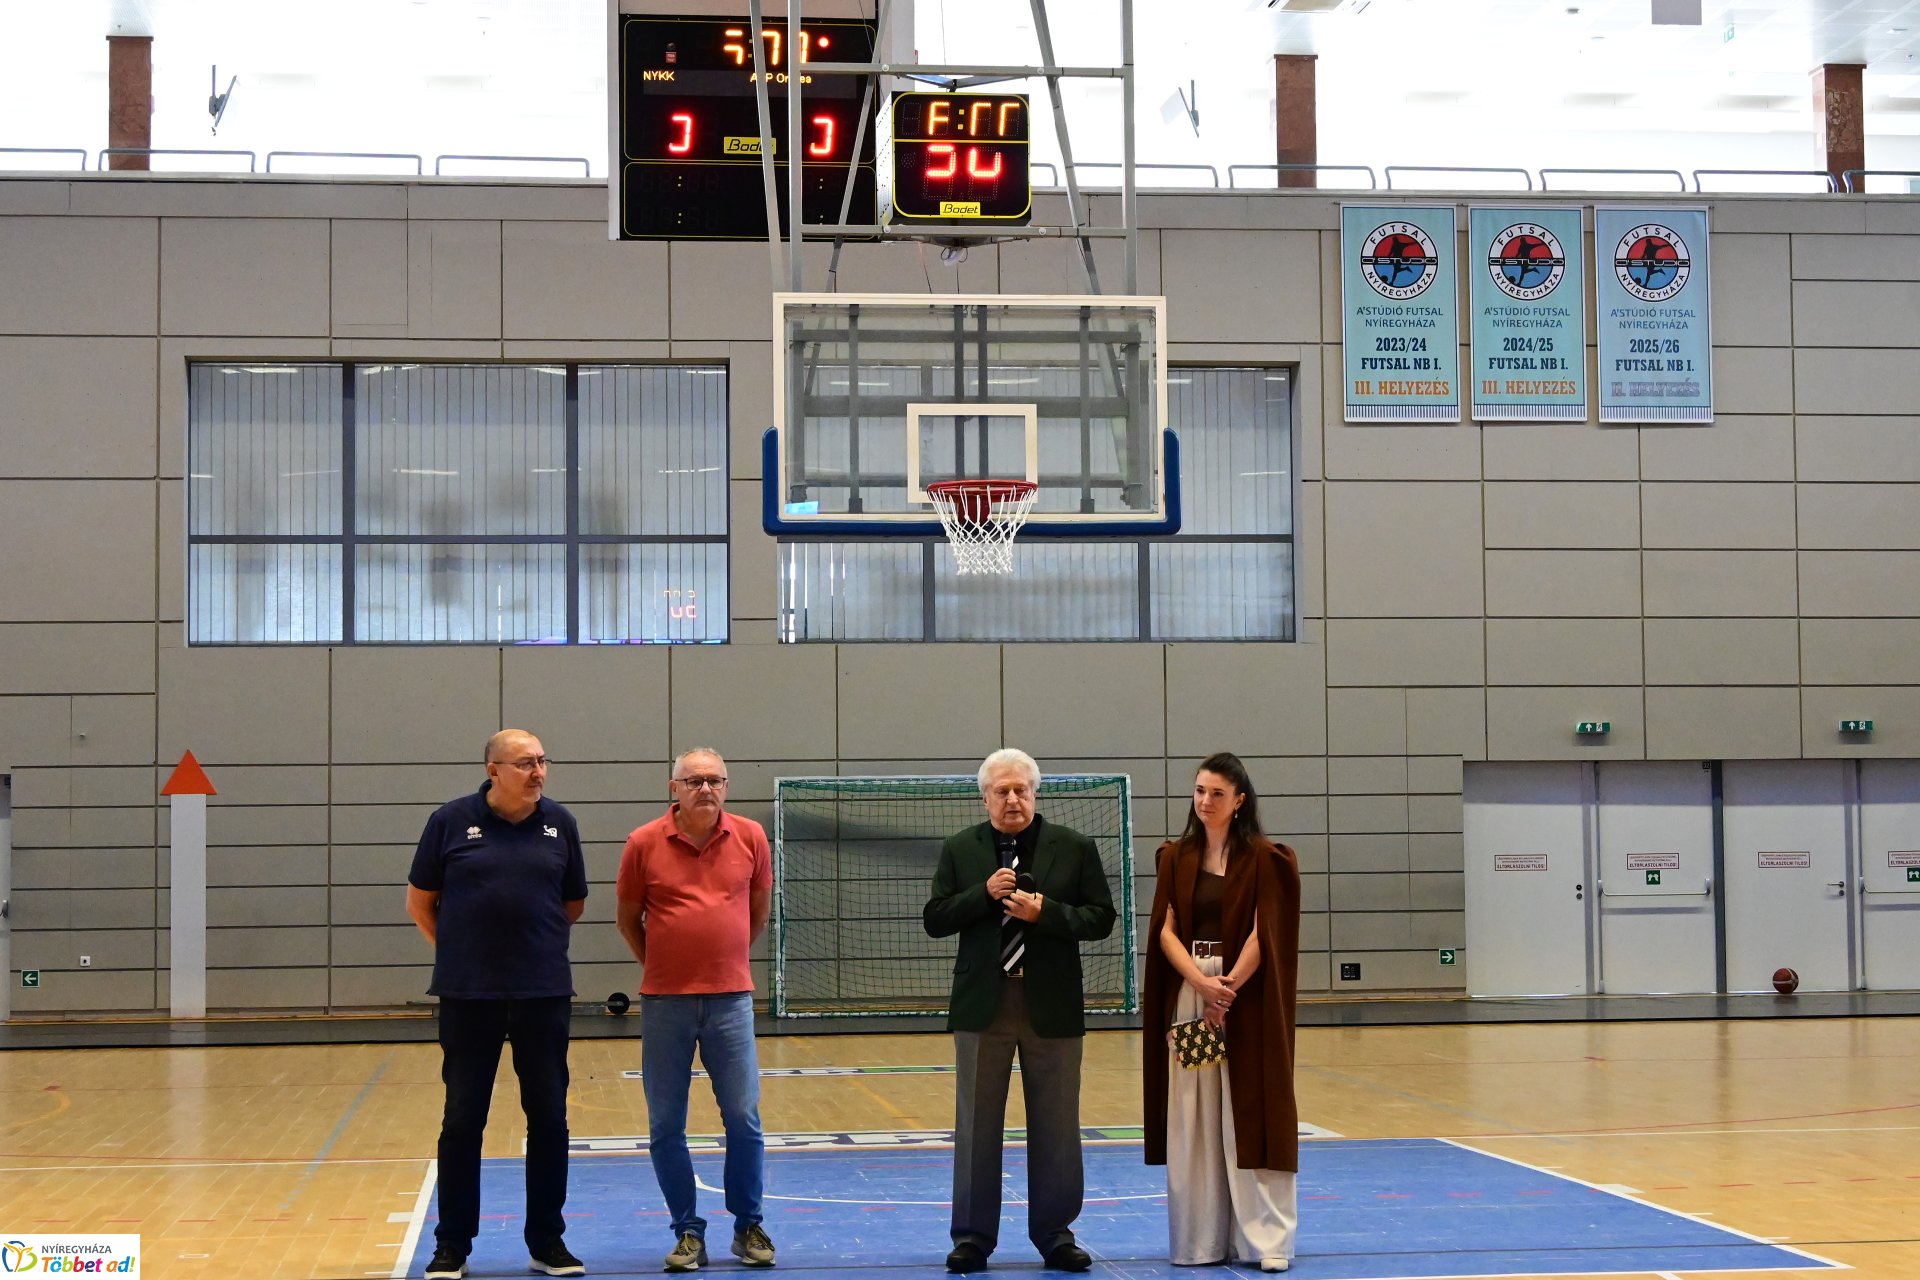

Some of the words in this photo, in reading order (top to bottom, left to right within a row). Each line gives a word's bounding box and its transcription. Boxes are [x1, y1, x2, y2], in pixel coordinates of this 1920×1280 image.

[643, 70, 675, 81] NYKK
[749, 72, 773, 83] AP
[727, 138, 774, 152] Bod
[942, 203, 979, 214] Bodet
[1370, 224, 1427, 246] FUTSAL
[1497, 226, 1554, 247] FUTSAL
[1623, 227, 1680, 248] FUTSAL
[1356, 304, 1403, 316] A'STÚDIÓ
[1406, 307, 1443, 316] FUTSAL
[1484, 305, 1531, 316] A'STÚDIÓ
[1533, 307, 1571, 317] FUTSAL
[1610, 306, 1657, 318] A'STÚDIÓ
[1659, 308, 1696, 318] FUTSAL
[1365, 317, 1436, 328] NYÍREGYHÁZA
[1492, 318, 1563, 328] NYÍREGYHÁZA
[1619, 319, 1689, 330] NYÍREGYHÁZA
[1376, 337, 1427, 353] 2023/24
[1503, 337, 1554, 353] 2024/25
[1629, 338, 1680, 355] 2025/26
[1361, 357, 1411, 370] FUTSAL
[1413, 357, 1431, 370] NB
[1433, 357, 1442, 370] I.
[1488, 357, 1538, 370] FUTSAL
[1540, 357, 1558, 370] NB
[1560, 357, 1569, 370] I.
[1615, 359, 1664, 372] FUTSAL
[1666, 359, 1684, 372] NB
[1686, 359, 1695, 372] I.
[1354, 380, 1374, 395] III.
[1378, 376, 1450, 396] HELYEZÉS
[1482, 380, 1501, 395] III.
[1505, 375, 1576, 395] HELYEZÉS
